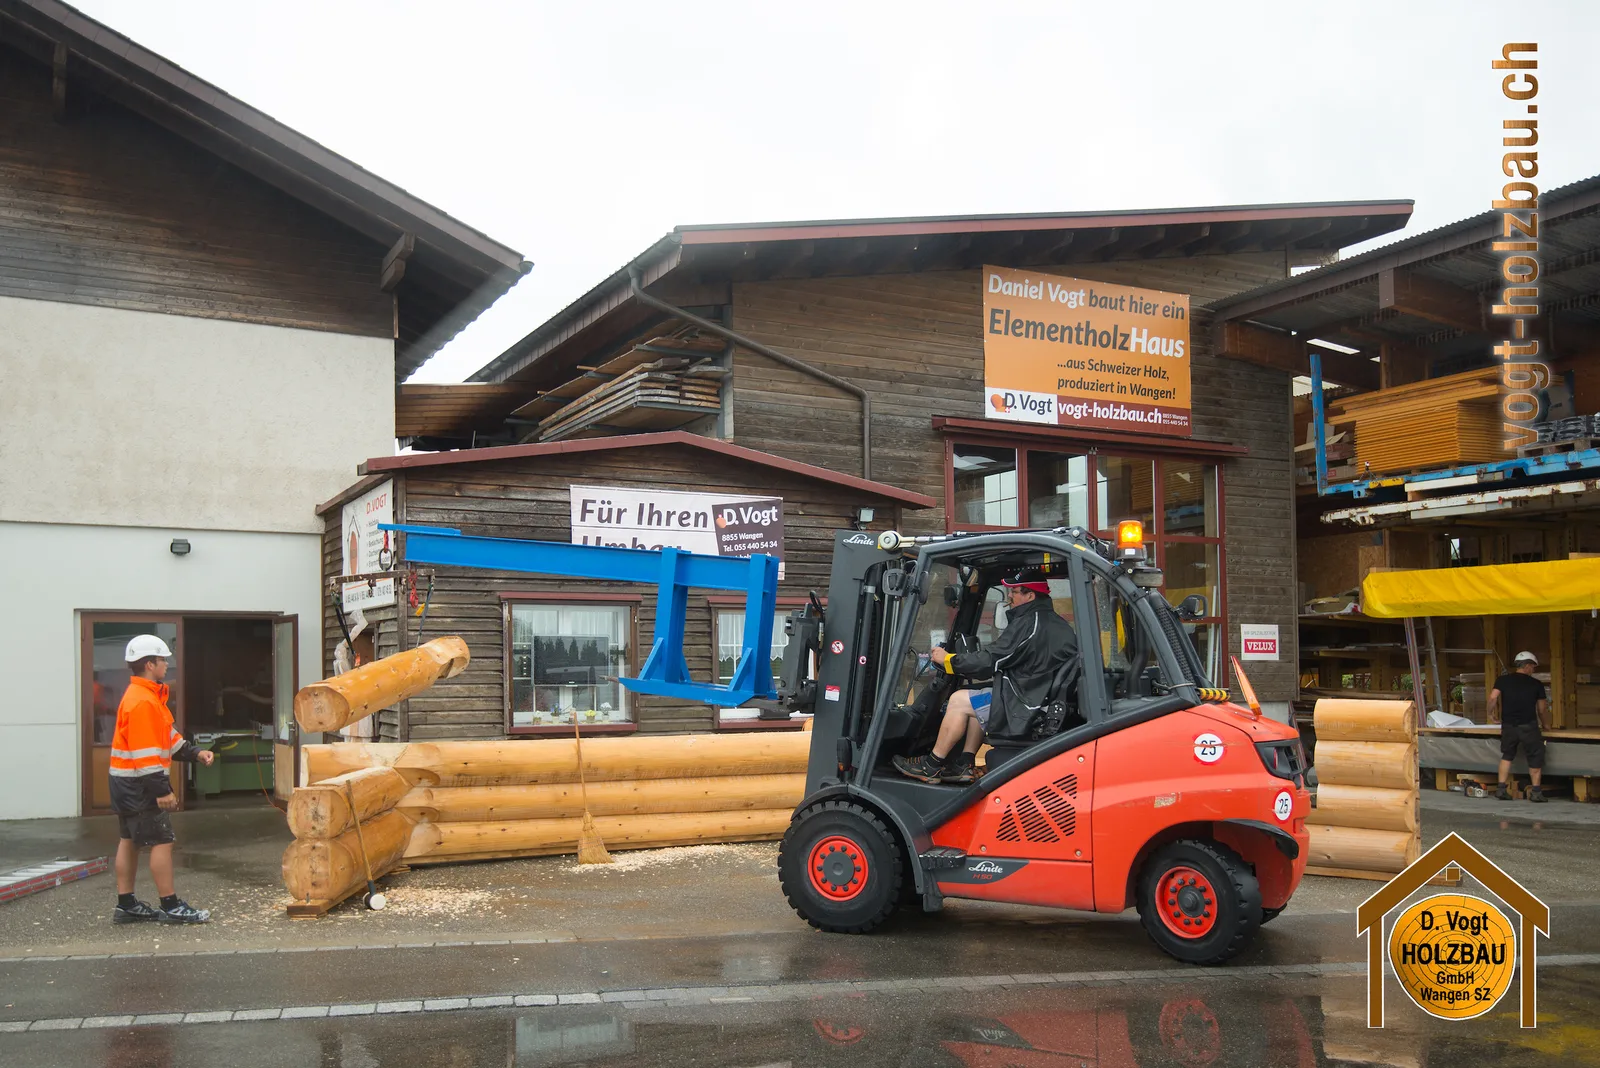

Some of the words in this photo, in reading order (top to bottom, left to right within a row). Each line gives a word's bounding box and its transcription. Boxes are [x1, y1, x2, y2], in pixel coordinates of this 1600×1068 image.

[988, 274, 1044, 300] Daniel
[1048, 283, 1085, 309] Vogt
[1088, 289, 1126, 312] baut
[1129, 294, 1159, 316] hier
[1162, 301, 1185, 320] ein
[989, 308, 1185, 358] ElementholzHaus
[1057, 358, 1085, 370] ...aus
[1087, 358, 1141, 376] Schweizer
[1144, 365, 1170, 381] Holz,
[1058, 377, 1114, 393] produziert
[1116, 382, 1127, 394] in
[1130, 383, 1176, 400] Wangen!
[1058, 401, 1162, 424] vogt-holzbau.ch
[580, 499, 628, 524] Für
[637, 502, 708, 528] Ihren
[722, 533, 738, 542] 8855
[738, 532, 764, 540] Wangen
[842, 534, 874, 546] Linde
[734, 544, 746, 552] 055
[747, 542, 760, 550] 440
[769, 540, 778, 548] 34
[1246, 642, 1274, 650] VELUX
[1201, 740, 1216, 756] 25
[1278, 798, 1288, 814] 25
[968, 860, 1003, 874] Linde
